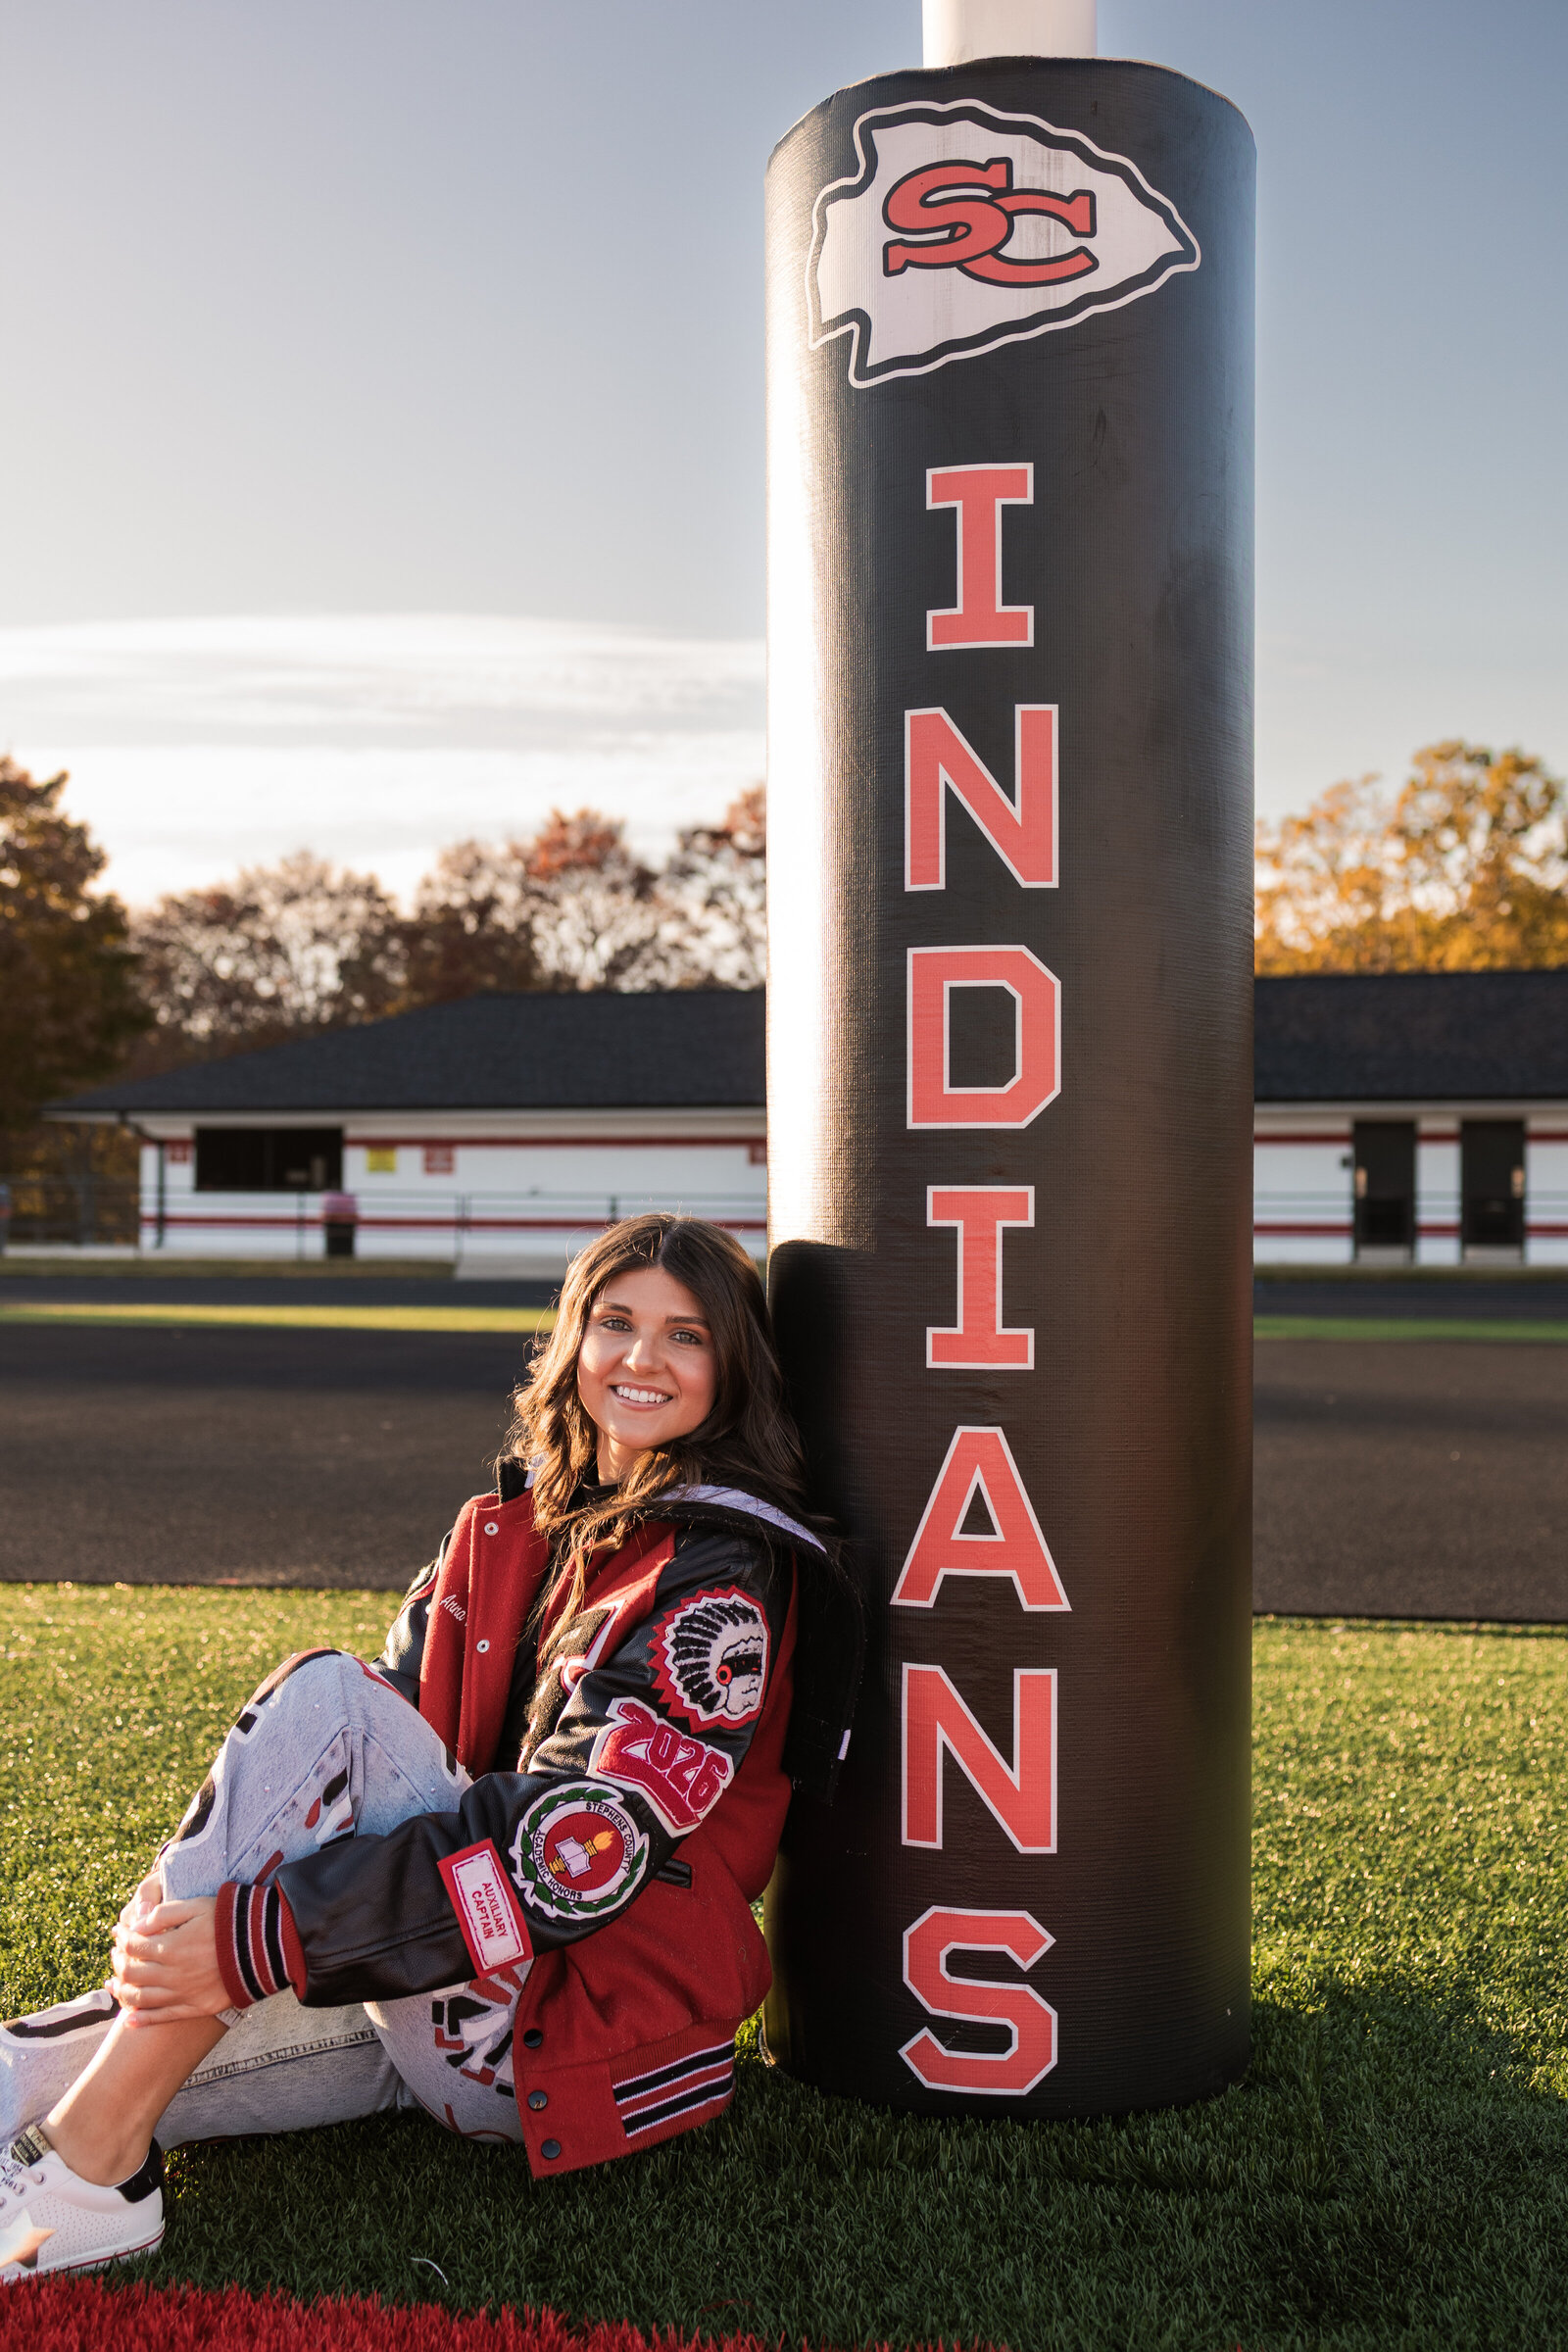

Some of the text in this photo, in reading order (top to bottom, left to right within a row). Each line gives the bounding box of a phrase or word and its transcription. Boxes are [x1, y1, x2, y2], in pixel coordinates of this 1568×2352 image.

[883, 157, 1100, 288] SC
[889, 462, 1073, 2096] INDIANS
[439, 1593, 466, 1622] Anna
[596, 1702, 729, 1830] 2026
[534, 1829, 583, 1900] ACADEMIC HONORS
[585, 1802, 633, 1875] STEPHENS COUNTY
[471, 1889, 495, 1940] CAPTAIN
[481, 1882, 509, 1937] AUXILIARY
